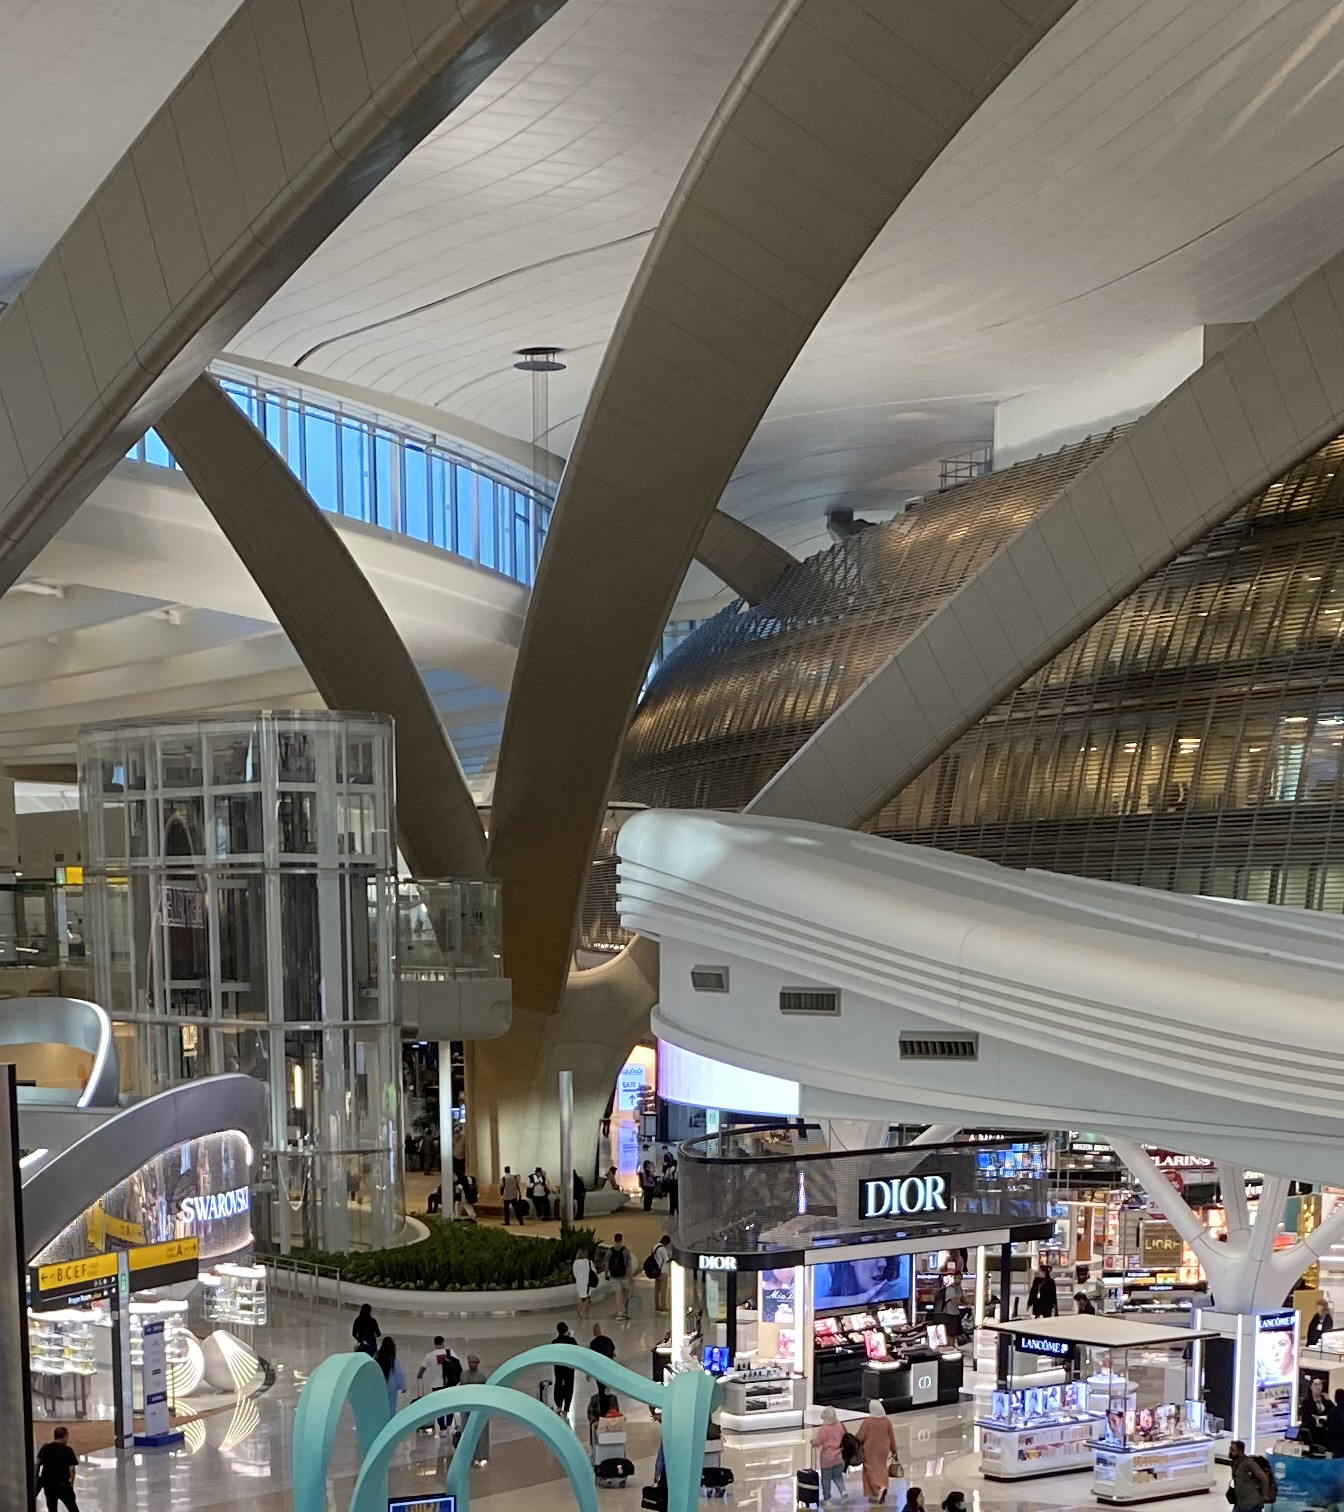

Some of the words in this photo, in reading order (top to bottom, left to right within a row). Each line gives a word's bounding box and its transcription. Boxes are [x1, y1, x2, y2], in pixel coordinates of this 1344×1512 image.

[1150, 1155, 1211, 1167] LARINS
[182, 1186, 250, 1223] SWAROVSKI
[864, 1175, 947, 1218] DIOR
[699, 1255, 737, 1270] DIOR
[1021, 1337, 1061, 1353] LANCÔME
